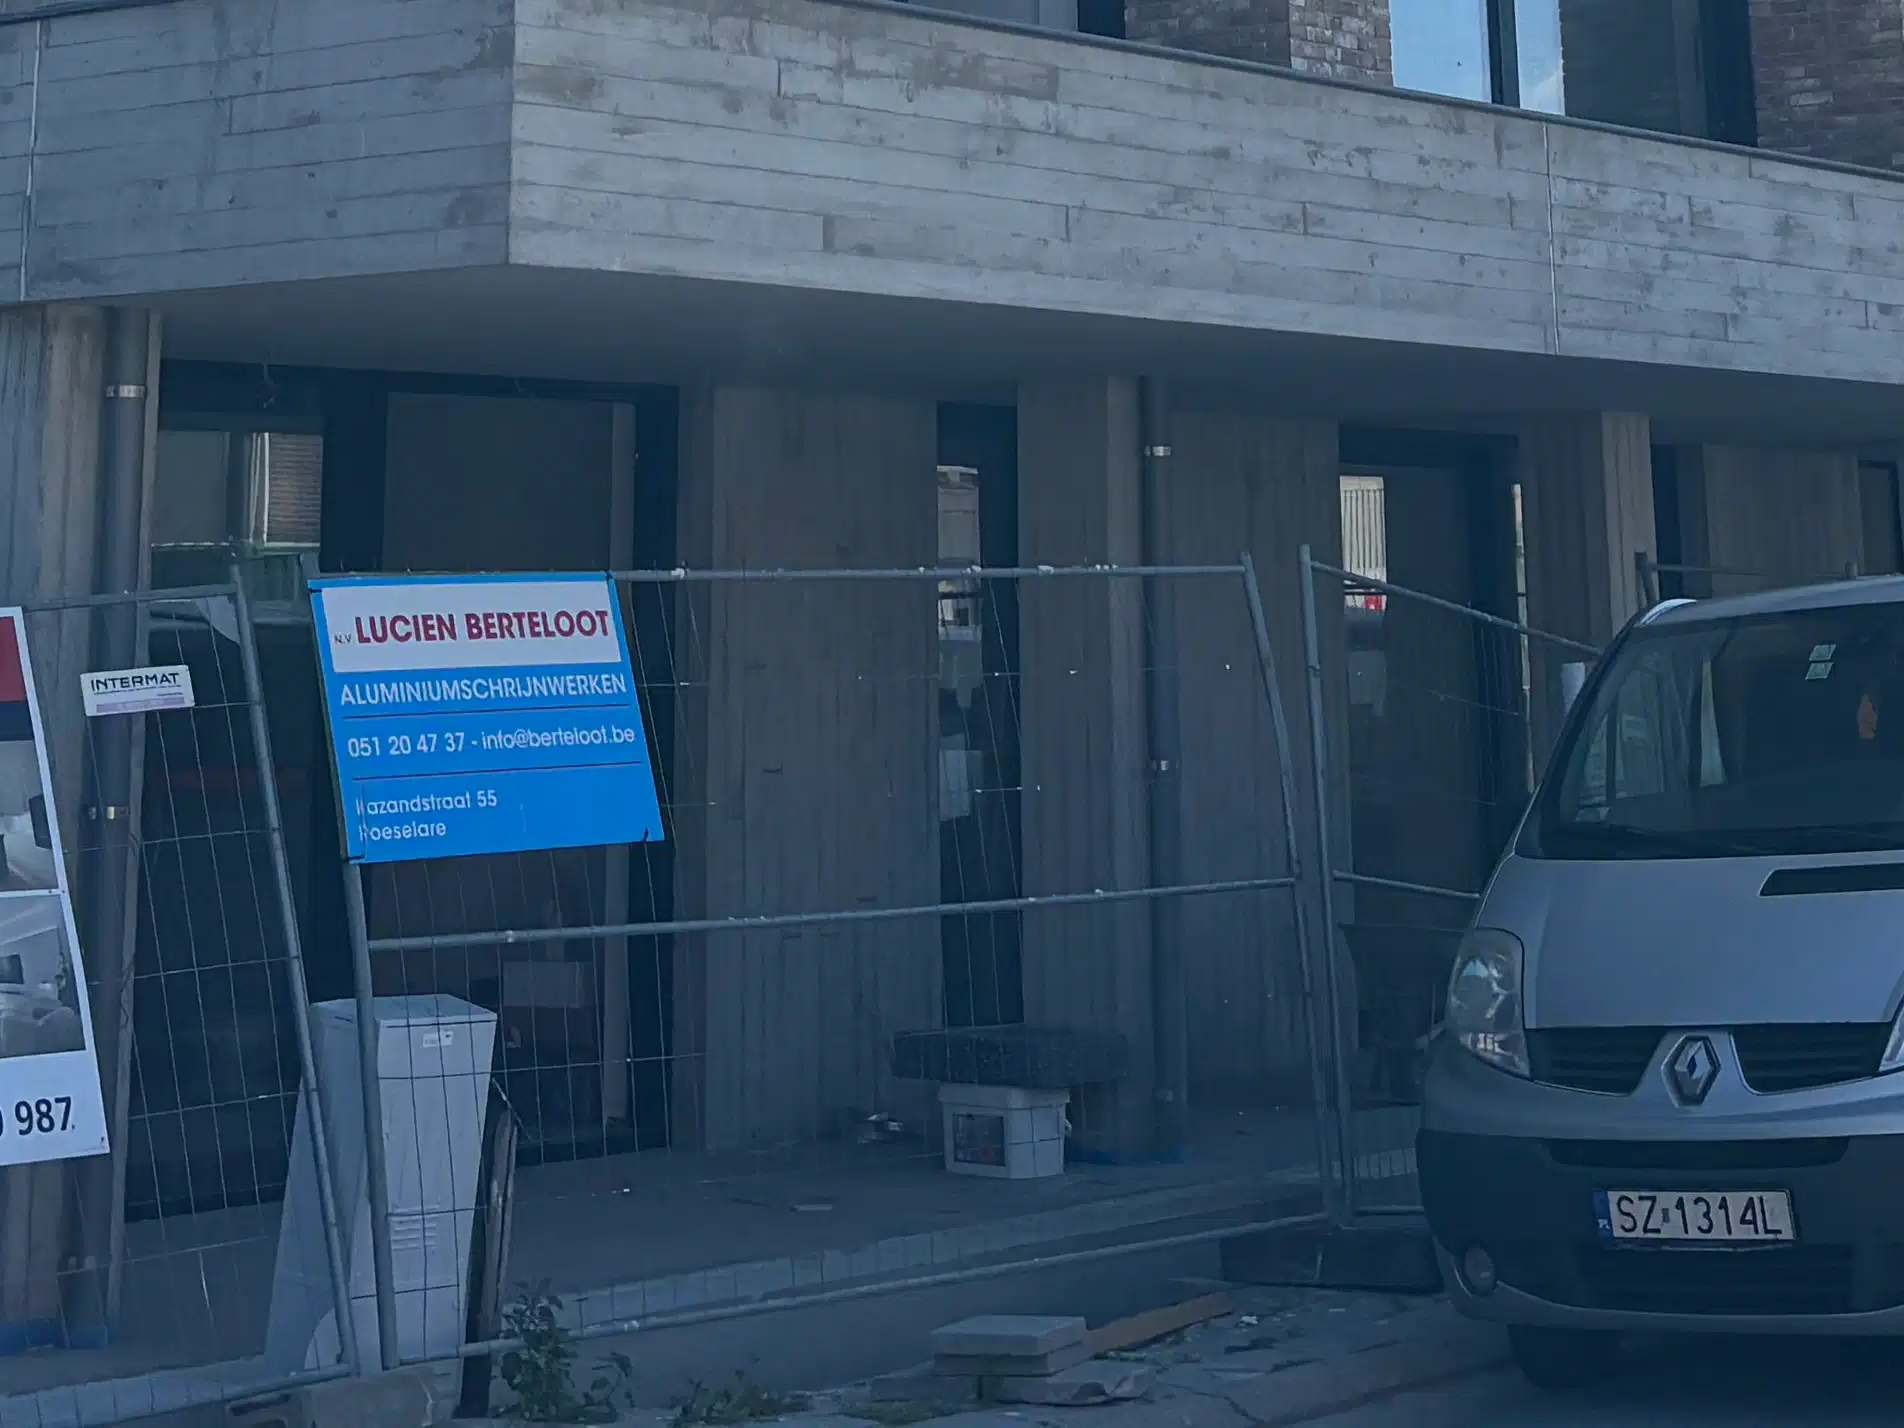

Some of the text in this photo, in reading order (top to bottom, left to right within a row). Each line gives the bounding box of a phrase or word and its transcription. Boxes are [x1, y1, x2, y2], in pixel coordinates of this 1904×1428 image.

[354, 613, 458, 644] LUCIEN
[464, 609, 609, 641] BERTELOOT
[90, 672, 180, 692] INTERMAT
[340, 672, 628, 706] ALUMINIUMSCHRIJNWERKEN
[347, 736, 381, 758] 051
[388, 734, 412, 756] 20
[416, 733, 438, 754] 47
[444, 731, 466, 753] 37
[480, 724, 636, 750] info@berteloot.be
[477, 789, 498, 808] 55
[13, 1096, 75, 1137] 987
[1616, 1195, 1662, 1234] SZ
[1674, 1195, 1784, 1236] 1314L
